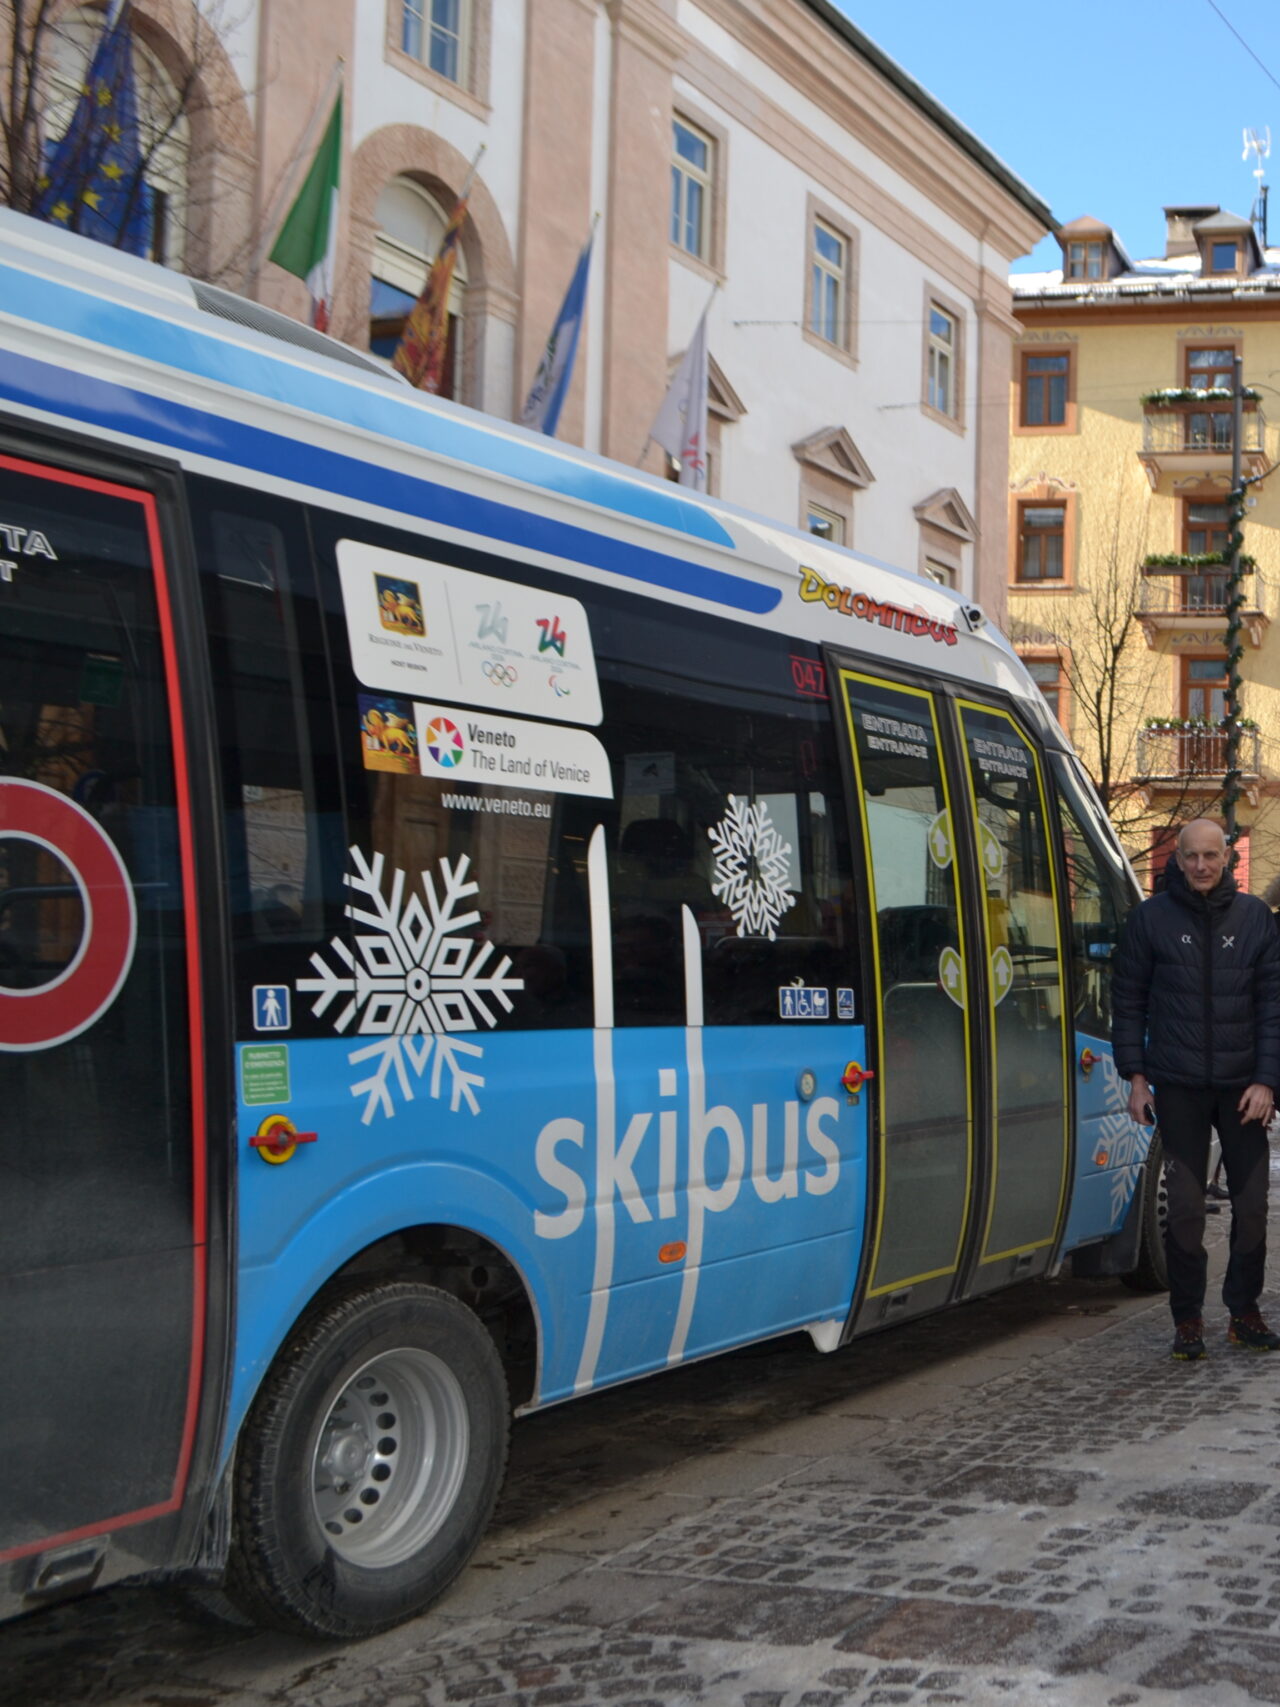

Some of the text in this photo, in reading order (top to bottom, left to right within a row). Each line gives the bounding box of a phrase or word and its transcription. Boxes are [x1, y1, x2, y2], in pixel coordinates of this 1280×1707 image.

[799, 565, 958, 646] DOLOMITIBUS
[791, 660, 825, 692] 047
[467, 723, 516, 749] Veneto
[861, 713, 928, 742] ENTRATA
[867, 735, 928, 759] ENTRANCE
[973, 737, 1027, 763] ENTRATA
[471, 749, 591, 783] The Land of Venice
[978, 757, 1028, 779] ENTRANCE
[441, 793, 551, 818] www.veneto.eu
